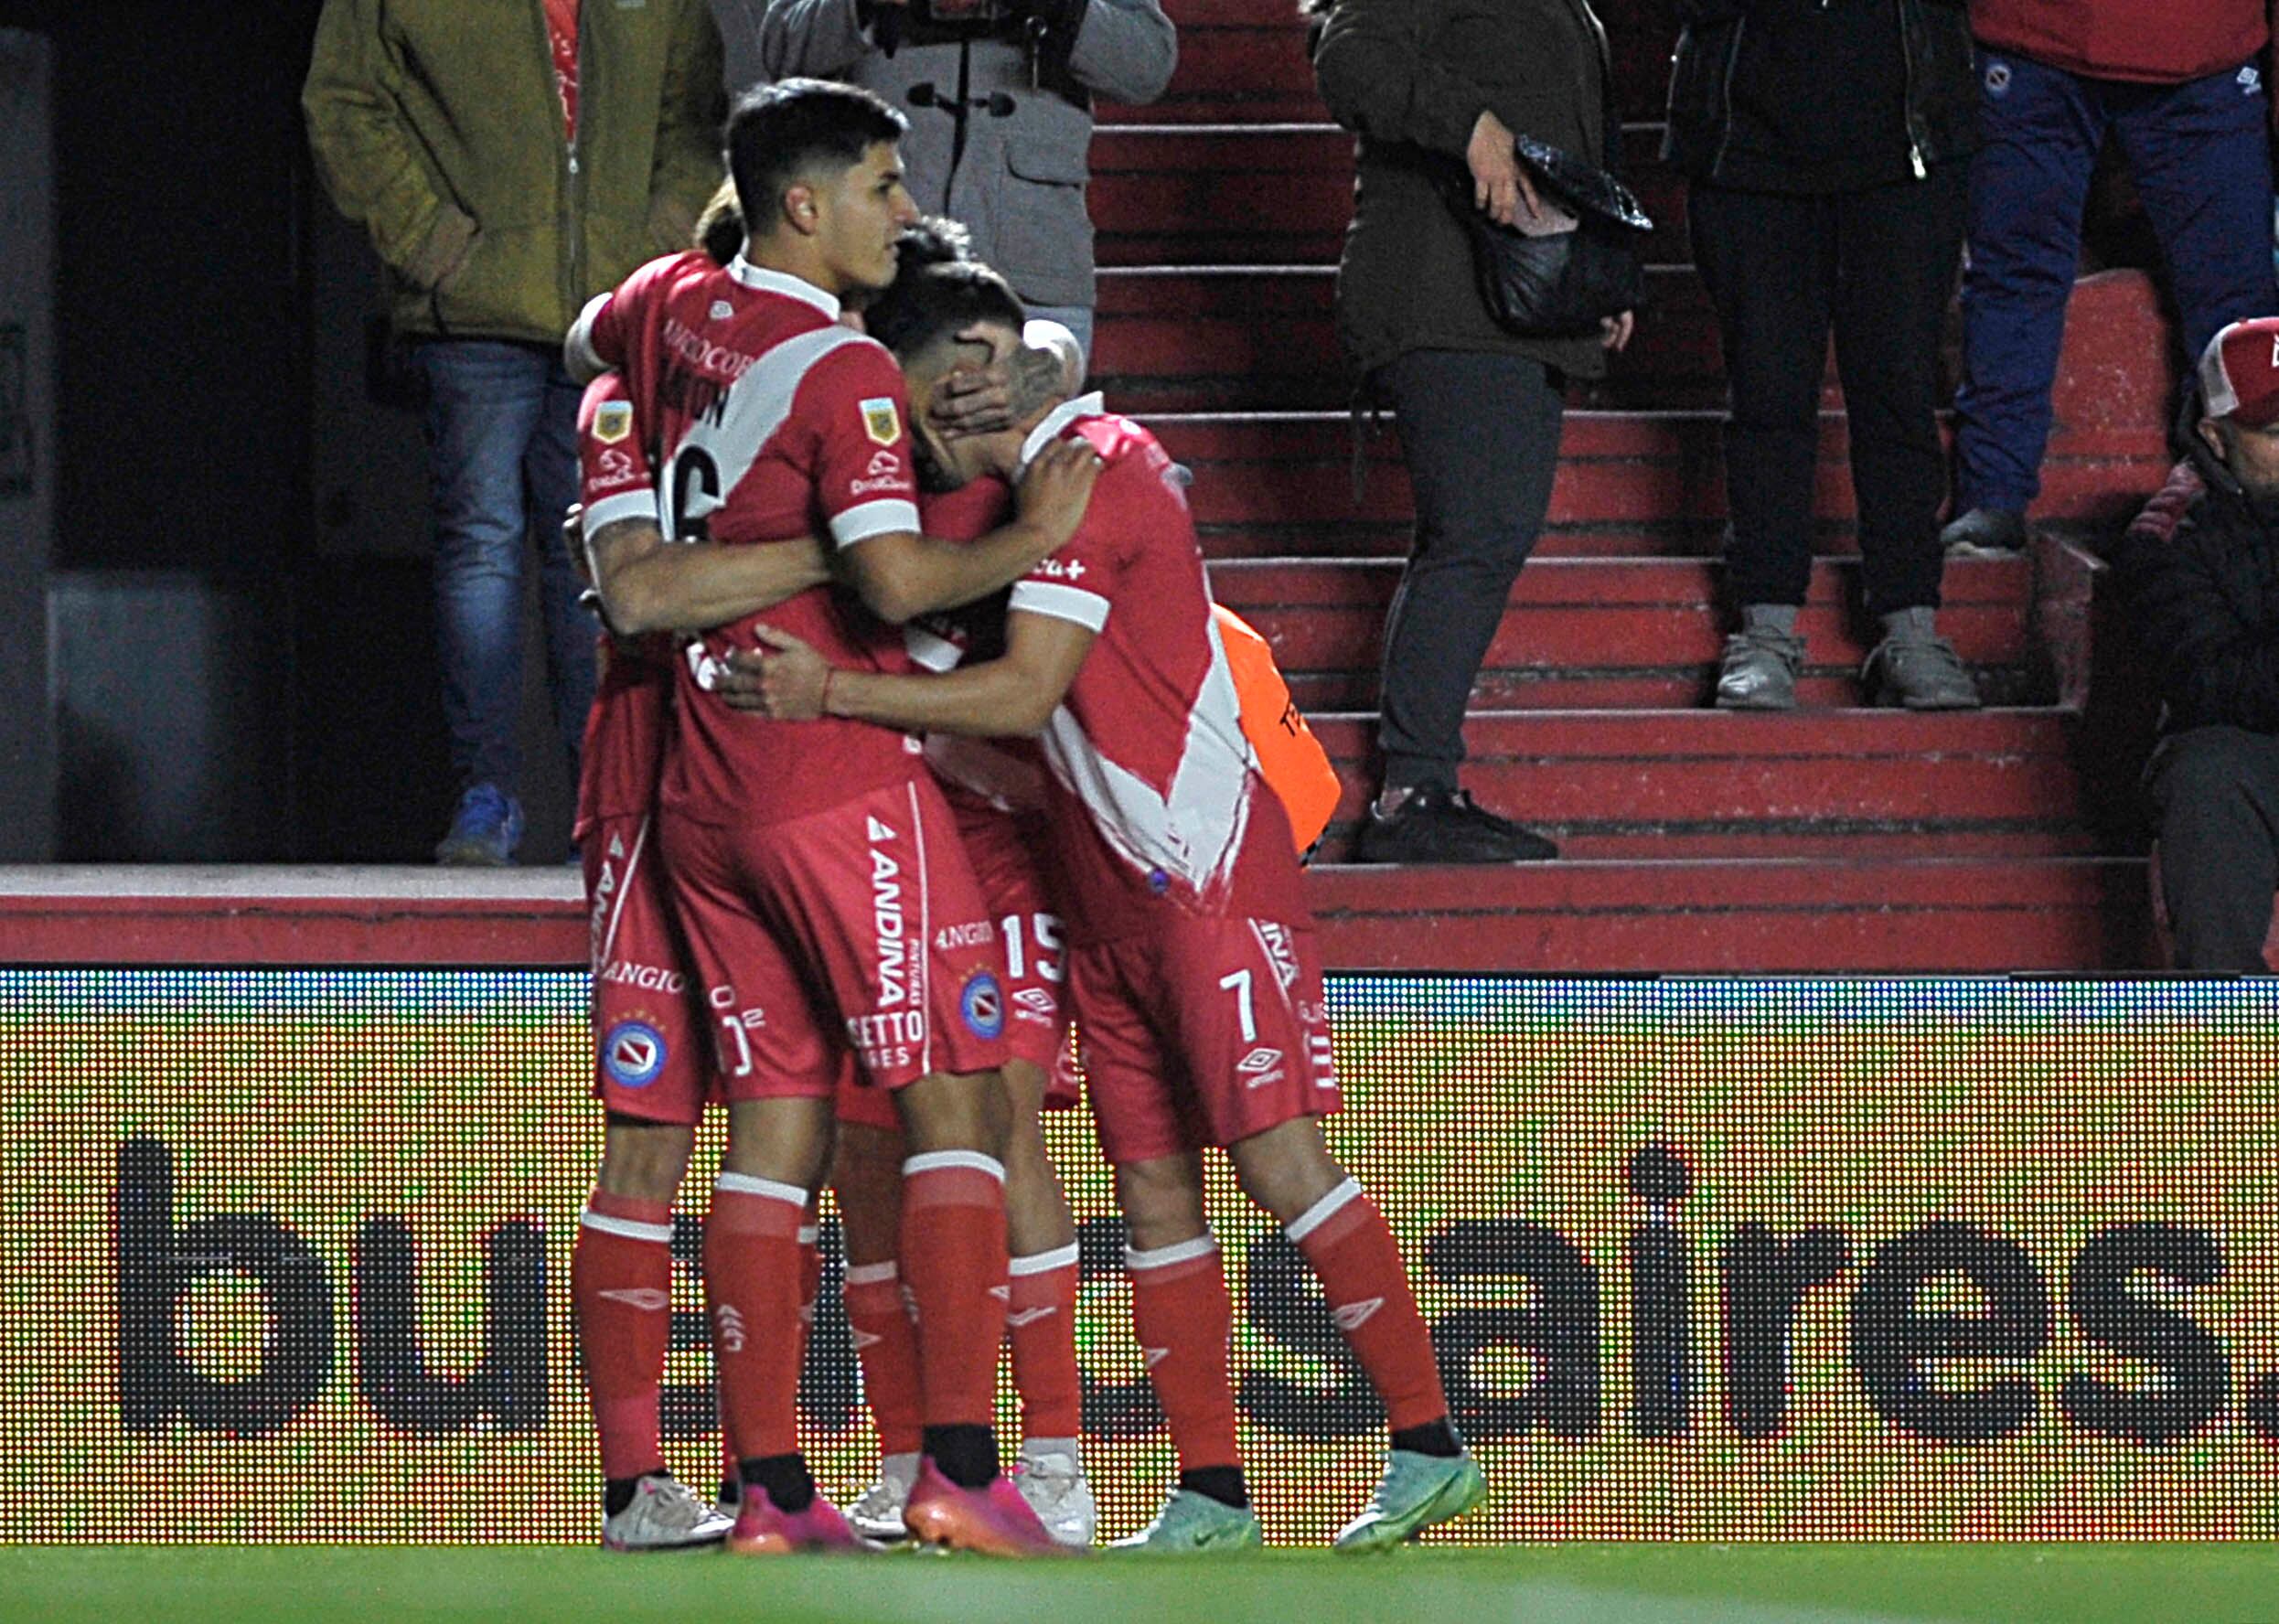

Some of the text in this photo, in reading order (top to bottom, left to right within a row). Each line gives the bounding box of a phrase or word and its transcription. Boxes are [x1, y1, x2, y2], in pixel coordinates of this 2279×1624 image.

[869, 848, 906, 1008] ANDINA
[1001, 913, 1067, 982] 15
[1219, 968, 1257, 1042] 7
